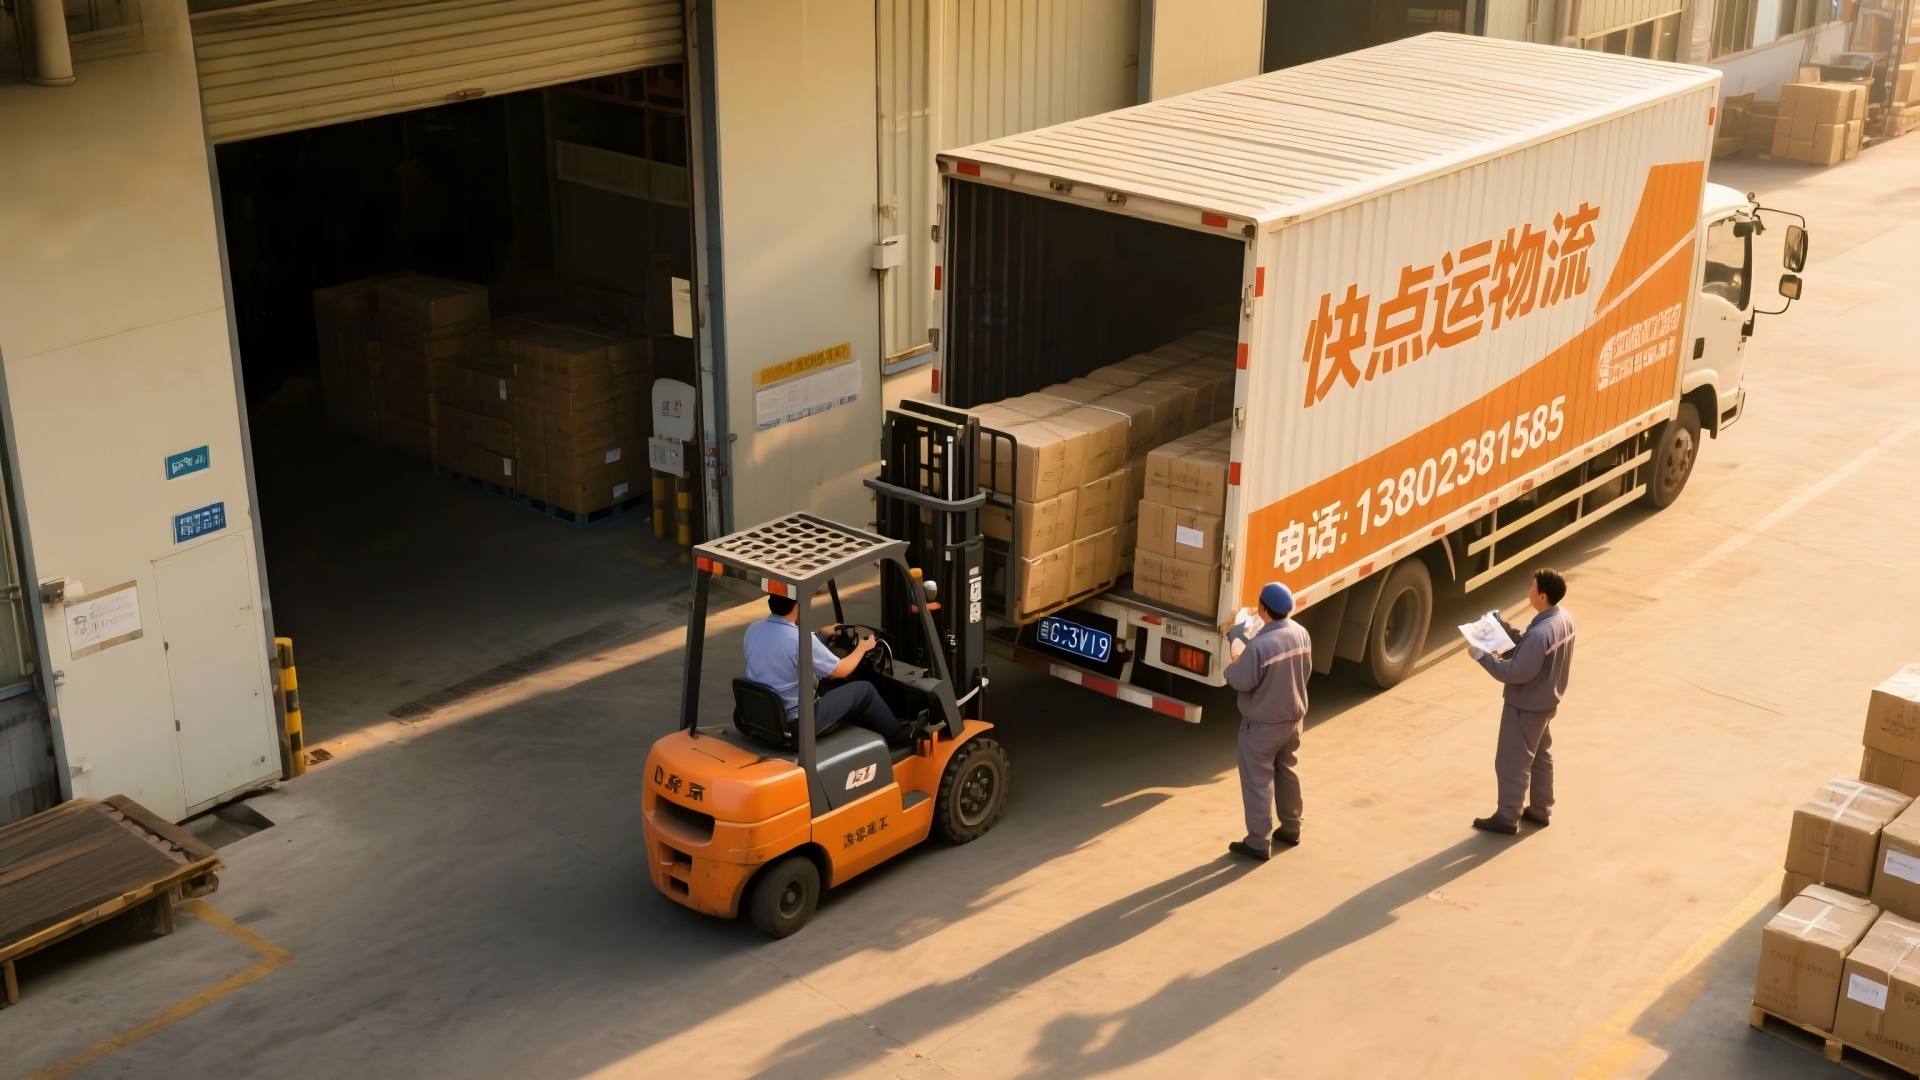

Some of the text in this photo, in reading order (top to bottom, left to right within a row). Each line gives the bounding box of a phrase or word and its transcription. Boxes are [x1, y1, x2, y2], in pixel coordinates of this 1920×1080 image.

[1302, 201, 1600, 409] 快点运物流
[1273, 395, 1566, 573] 电话: 13802381585
